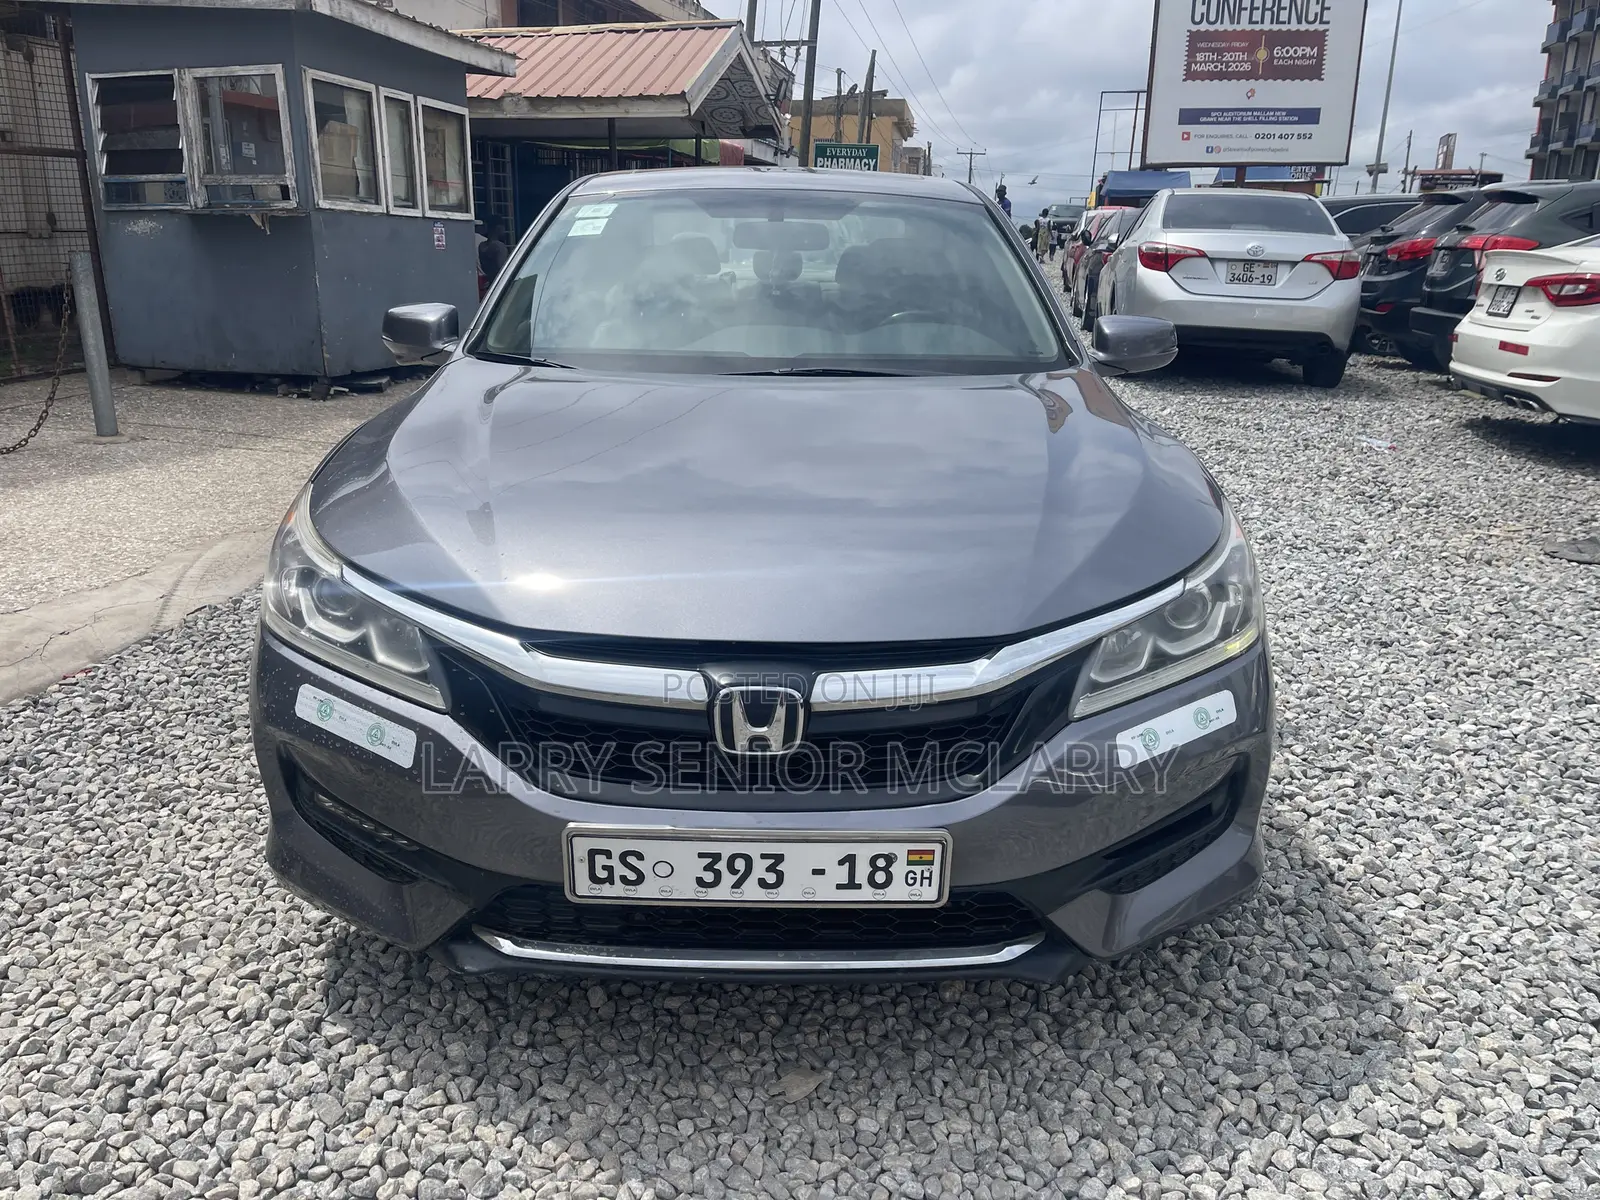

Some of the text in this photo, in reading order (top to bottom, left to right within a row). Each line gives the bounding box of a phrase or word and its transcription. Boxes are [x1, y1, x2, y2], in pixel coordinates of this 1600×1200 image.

[1190, 0, 1331, 25] CONFERENCE
[1273, 46, 1318, 58] 6:00PM
[1228, 62, 1252, 71] 2026
[826, 148, 868, 156] EVERYDAY
[816, 158, 877, 172] PHARMACY
[1242, 262, 1256, 272] GE
[1229, 272, 1273, 284] 3406-19
[587, 848, 646, 886] GS
[695, 852, 785, 890] 393
[904, 868, 933, 888] GH
